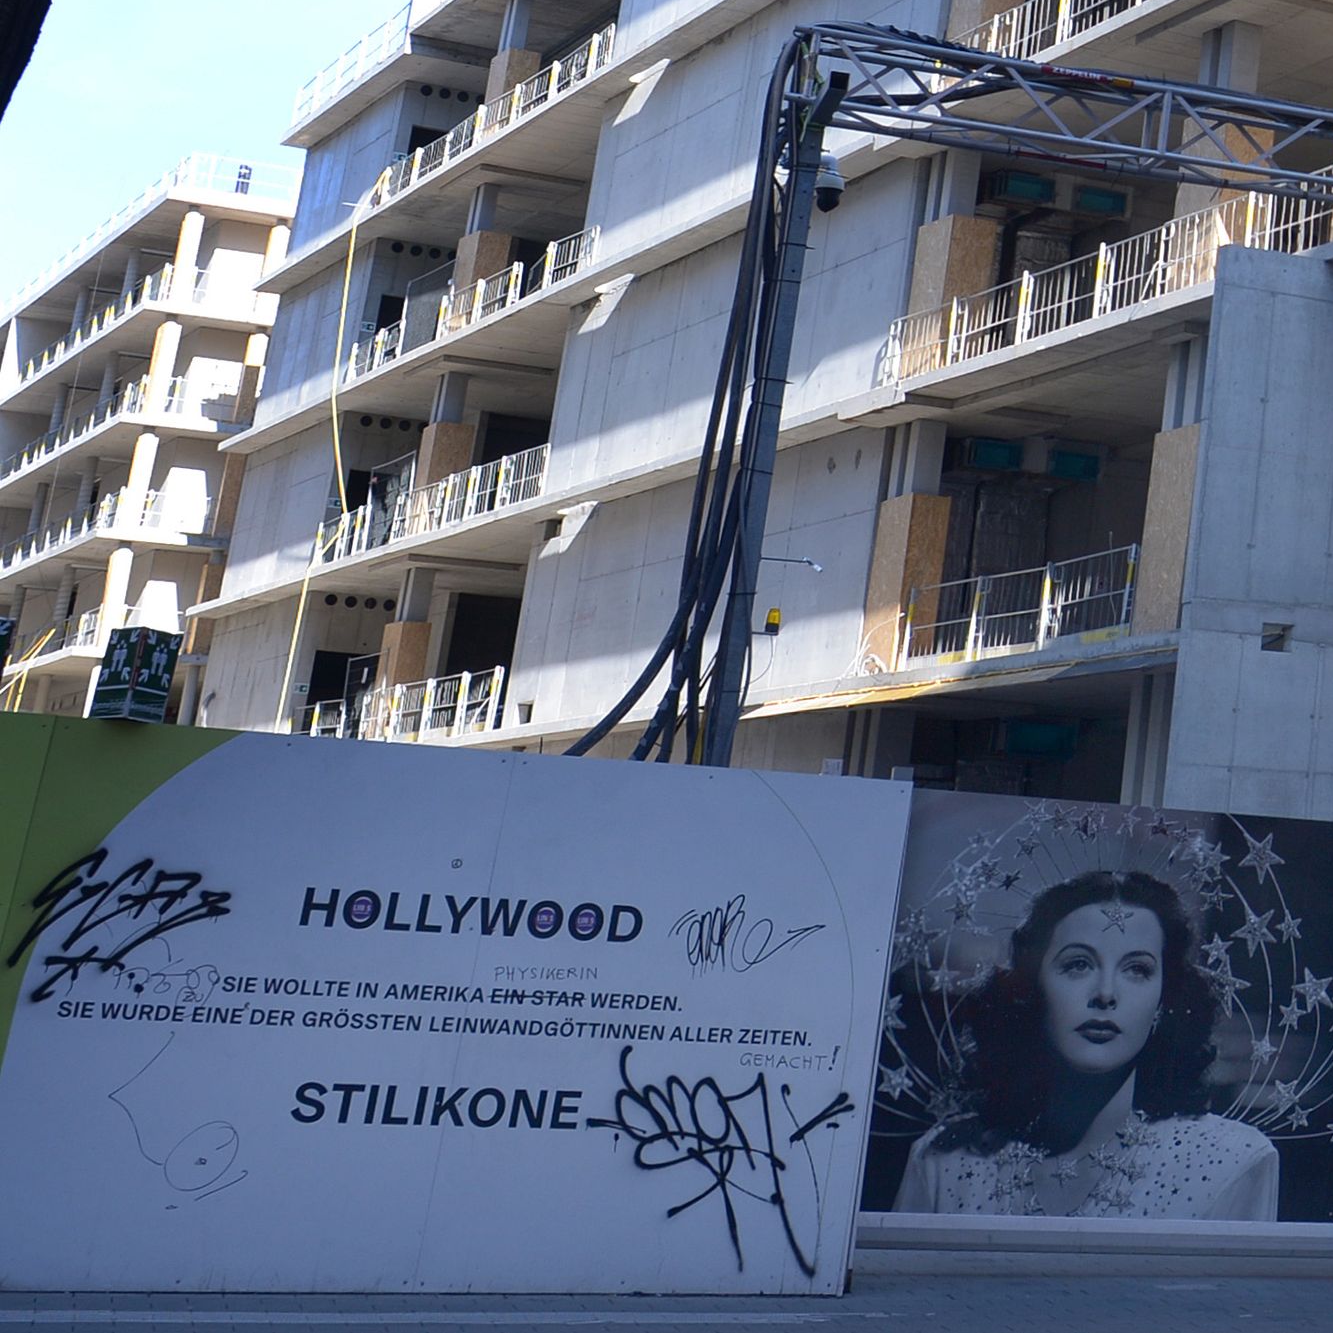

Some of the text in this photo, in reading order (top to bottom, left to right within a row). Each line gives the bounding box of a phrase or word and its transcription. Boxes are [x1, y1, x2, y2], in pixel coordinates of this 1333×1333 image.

[1053, 67, 1101, 81] ZEPPELIN
[299, 887, 643, 942] HOLLYWOOD
[221, 976, 258, 994] SIE
[264, 978, 351, 998] WOLLTE
[355, 982, 379, 999] IN
[383, 984, 485, 1004] AMERIKA
[531, 990, 584, 1007] STAR
[590, 993, 683, 1012] WERDEN.
[494, 966, 599, 981] PHYSIKERIN
[57, 1001, 813, 1047] SIE WURDE EINE DER GRÖSSTEN LEINWANDGÖTTINNEN ALLER ZEITEN.
[290, 1081, 583, 1130] STILIKONE
